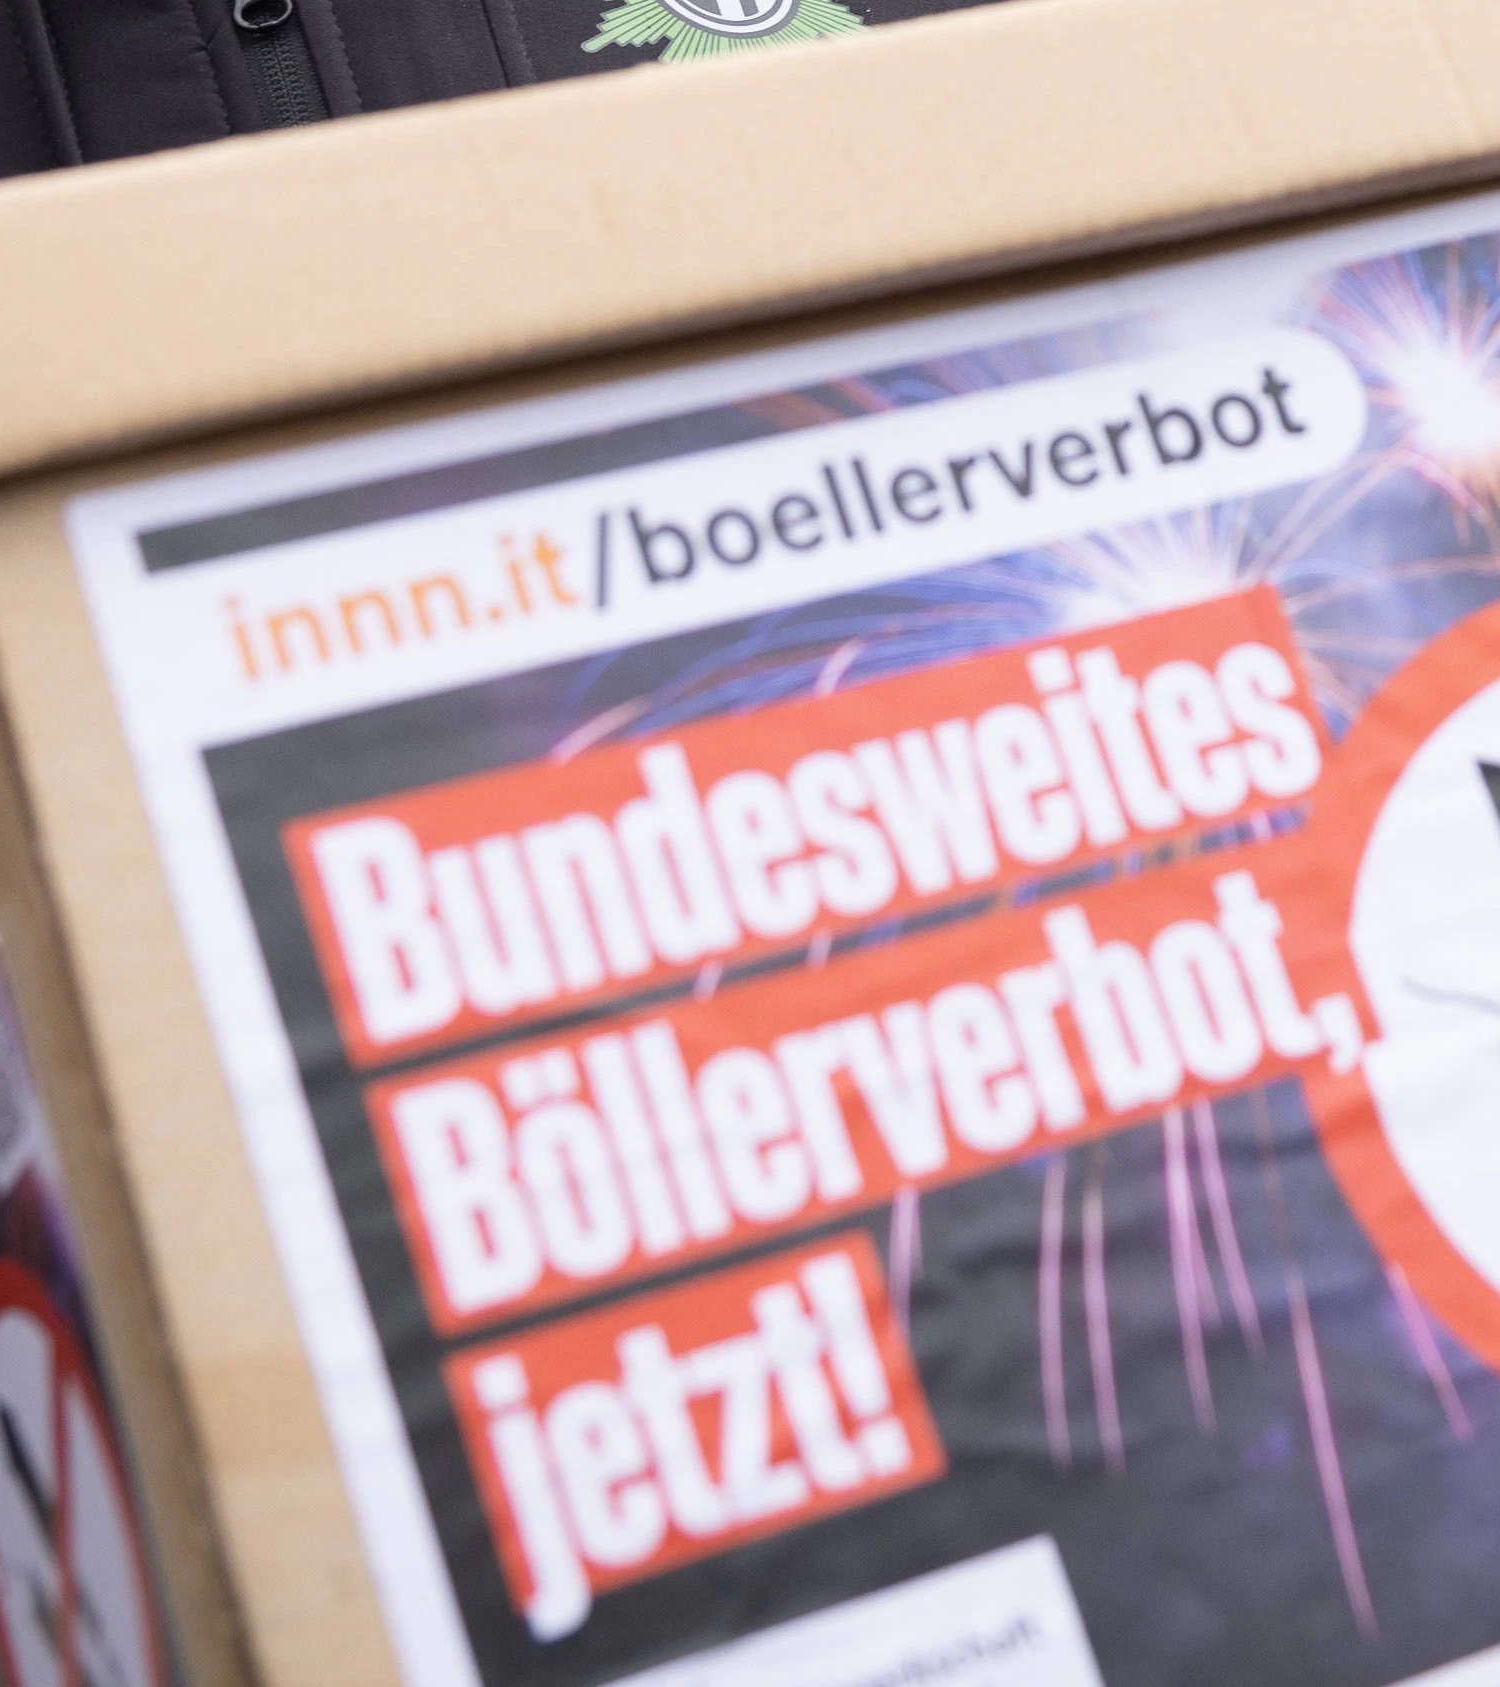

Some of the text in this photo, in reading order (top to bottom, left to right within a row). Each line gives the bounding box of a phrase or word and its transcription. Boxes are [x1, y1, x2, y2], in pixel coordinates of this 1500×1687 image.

[224, 364, 1308, 684] innn.it/boellerverbot
[310, 640, 1322, 1046] Bundesweites
[390, 868, 1366, 1314] Böllerverbot,
[470, 1250, 914, 1644] jetzt!
